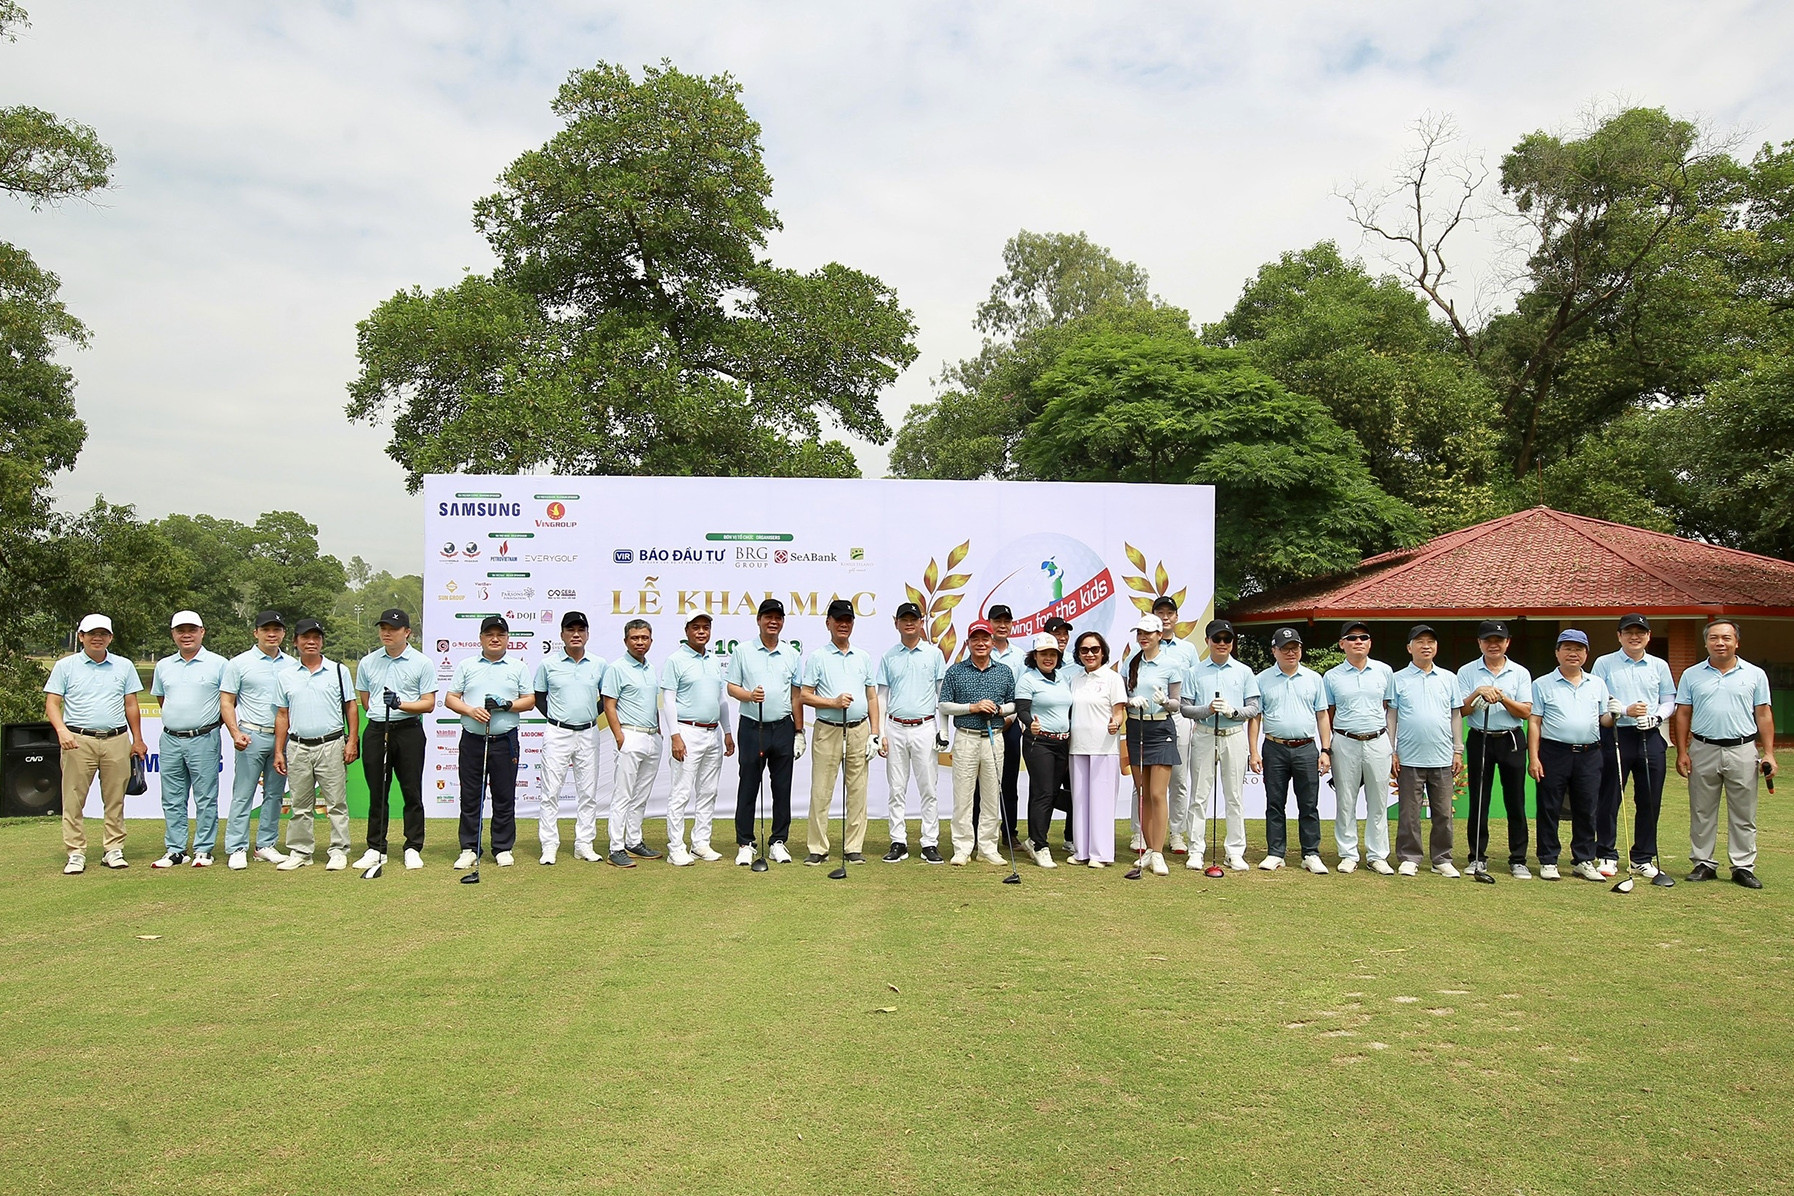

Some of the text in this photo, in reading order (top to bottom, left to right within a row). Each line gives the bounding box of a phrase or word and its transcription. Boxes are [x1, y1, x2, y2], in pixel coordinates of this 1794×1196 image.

[439, 502, 521, 517] SAMSUNG
[535, 519, 577, 528] VINGROUP
[616, 552, 631, 561] VIR
[640, 546, 726, 561] BÁO ĐẦU TƯ
[736, 547, 768, 560] BRG
[790, 552, 838, 562] SeABank
[610, 576, 663, 615] LỄ
[1010, 620, 1033, 636] wing
[1056, 599, 1077, 620] the
[1079, 579, 1108, 610] kids
[517, 612, 536, 621] DOJI
